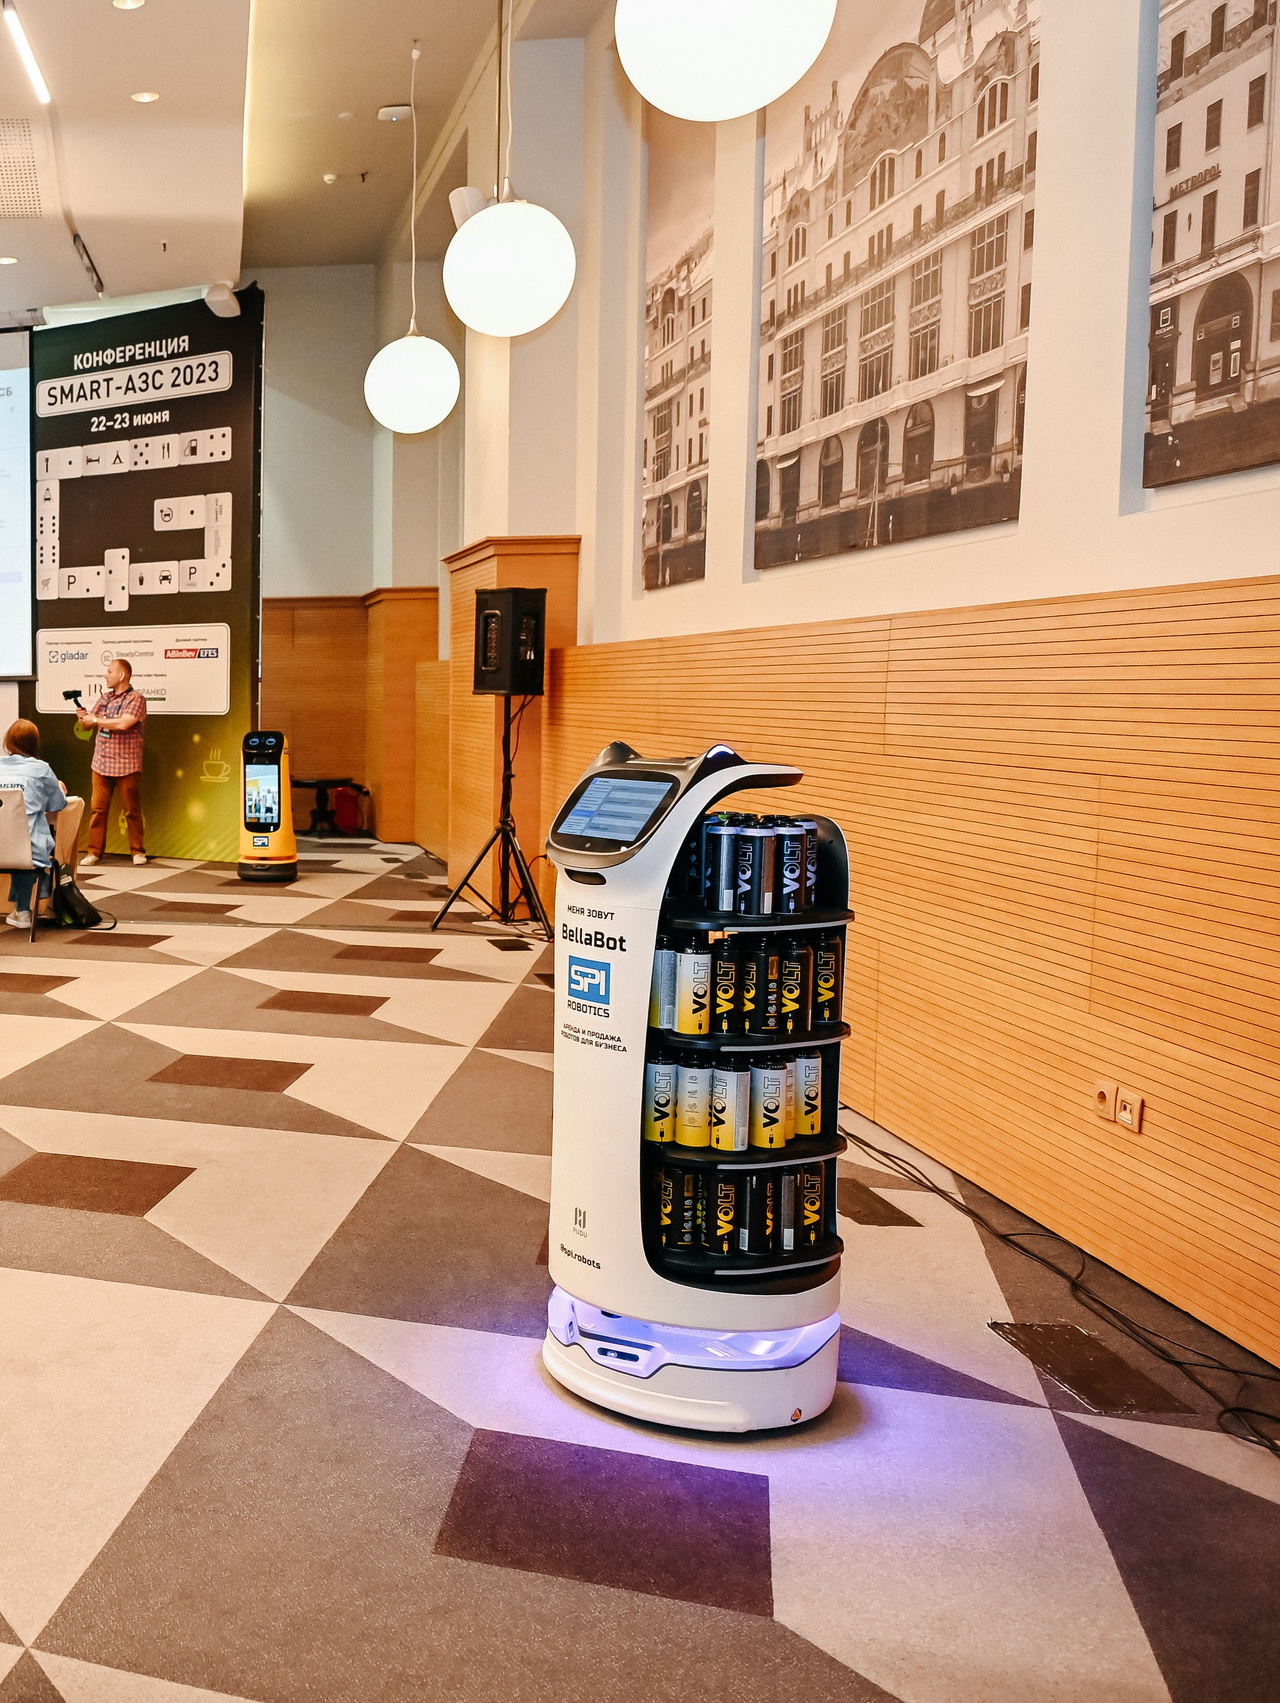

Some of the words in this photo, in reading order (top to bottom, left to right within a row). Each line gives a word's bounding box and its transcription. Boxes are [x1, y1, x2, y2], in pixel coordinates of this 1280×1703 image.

[73, 335, 189, 370] КОНФЕРЕНЦИЯ
[47, 369, 164, 406] SMART-АЗС
[170, 360, 219, 388] 2023
[132, 410, 170, 427] июня
[60, 651, 88, 662] gladar
[738, 841, 753, 894] VOLT
[783, 840, 801, 894] VOLT
[806, 835, 818, 888] VOLT
[562, 923, 627, 952] BellaBot
[567, 905, 585, 916] МЕНЯ
[586, 909, 615, 921] ЗОВУТ
[570, 964, 606, 996] SPI
[692, 961, 710, 1015] VOLT
[716, 960, 736, 1014] VOLT
[743, 961, 756, 1012] VOLT
[781, 960, 801, 1014] VOLT
[817, 951, 835, 1003] VOLT
[563, 1023, 581, 1034] АРЕНДА
[587, 1030, 622, 1043] ПРОДАЖА
[567, 1000, 610, 1018] ROBOTICS
[560, 1030, 580, 1043] РОБОТОВ
[581, 1037, 593, 1047] ДЛЯ
[653, 1071, 672, 1122] VOLT
[712, 1075, 728, 1128] VOLT
[762, 1076, 780, 1128] VOLT
[804, 1065, 819, 1116] VOLT
[717, 1183, 735, 1236] VOLT
[804, 1174, 821, 1226] VOLT
[572, 1226, 588, 1238] PUDU
